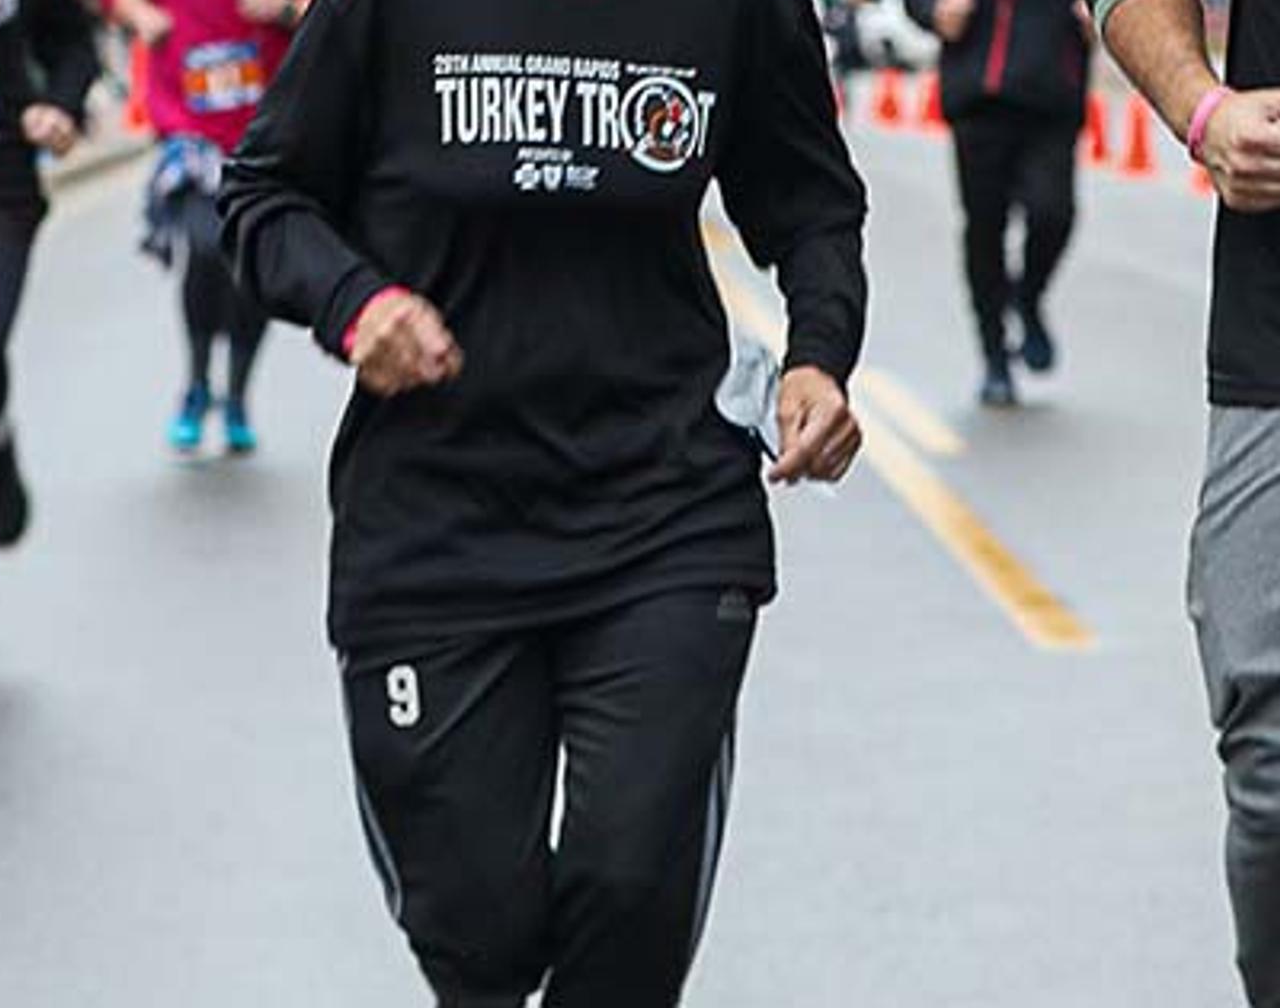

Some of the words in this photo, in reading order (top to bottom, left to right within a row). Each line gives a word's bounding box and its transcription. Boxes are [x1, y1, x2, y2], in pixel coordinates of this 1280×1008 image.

[471, 53, 524, 75] ANNUAL
[524, 54, 571, 76] GRAND
[573, 57, 620, 81] RAPIDS
[435, 76, 569, 144] TURKEY
[576, 76, 716, 172] TROT
[386, 664, 420, 727] 9
